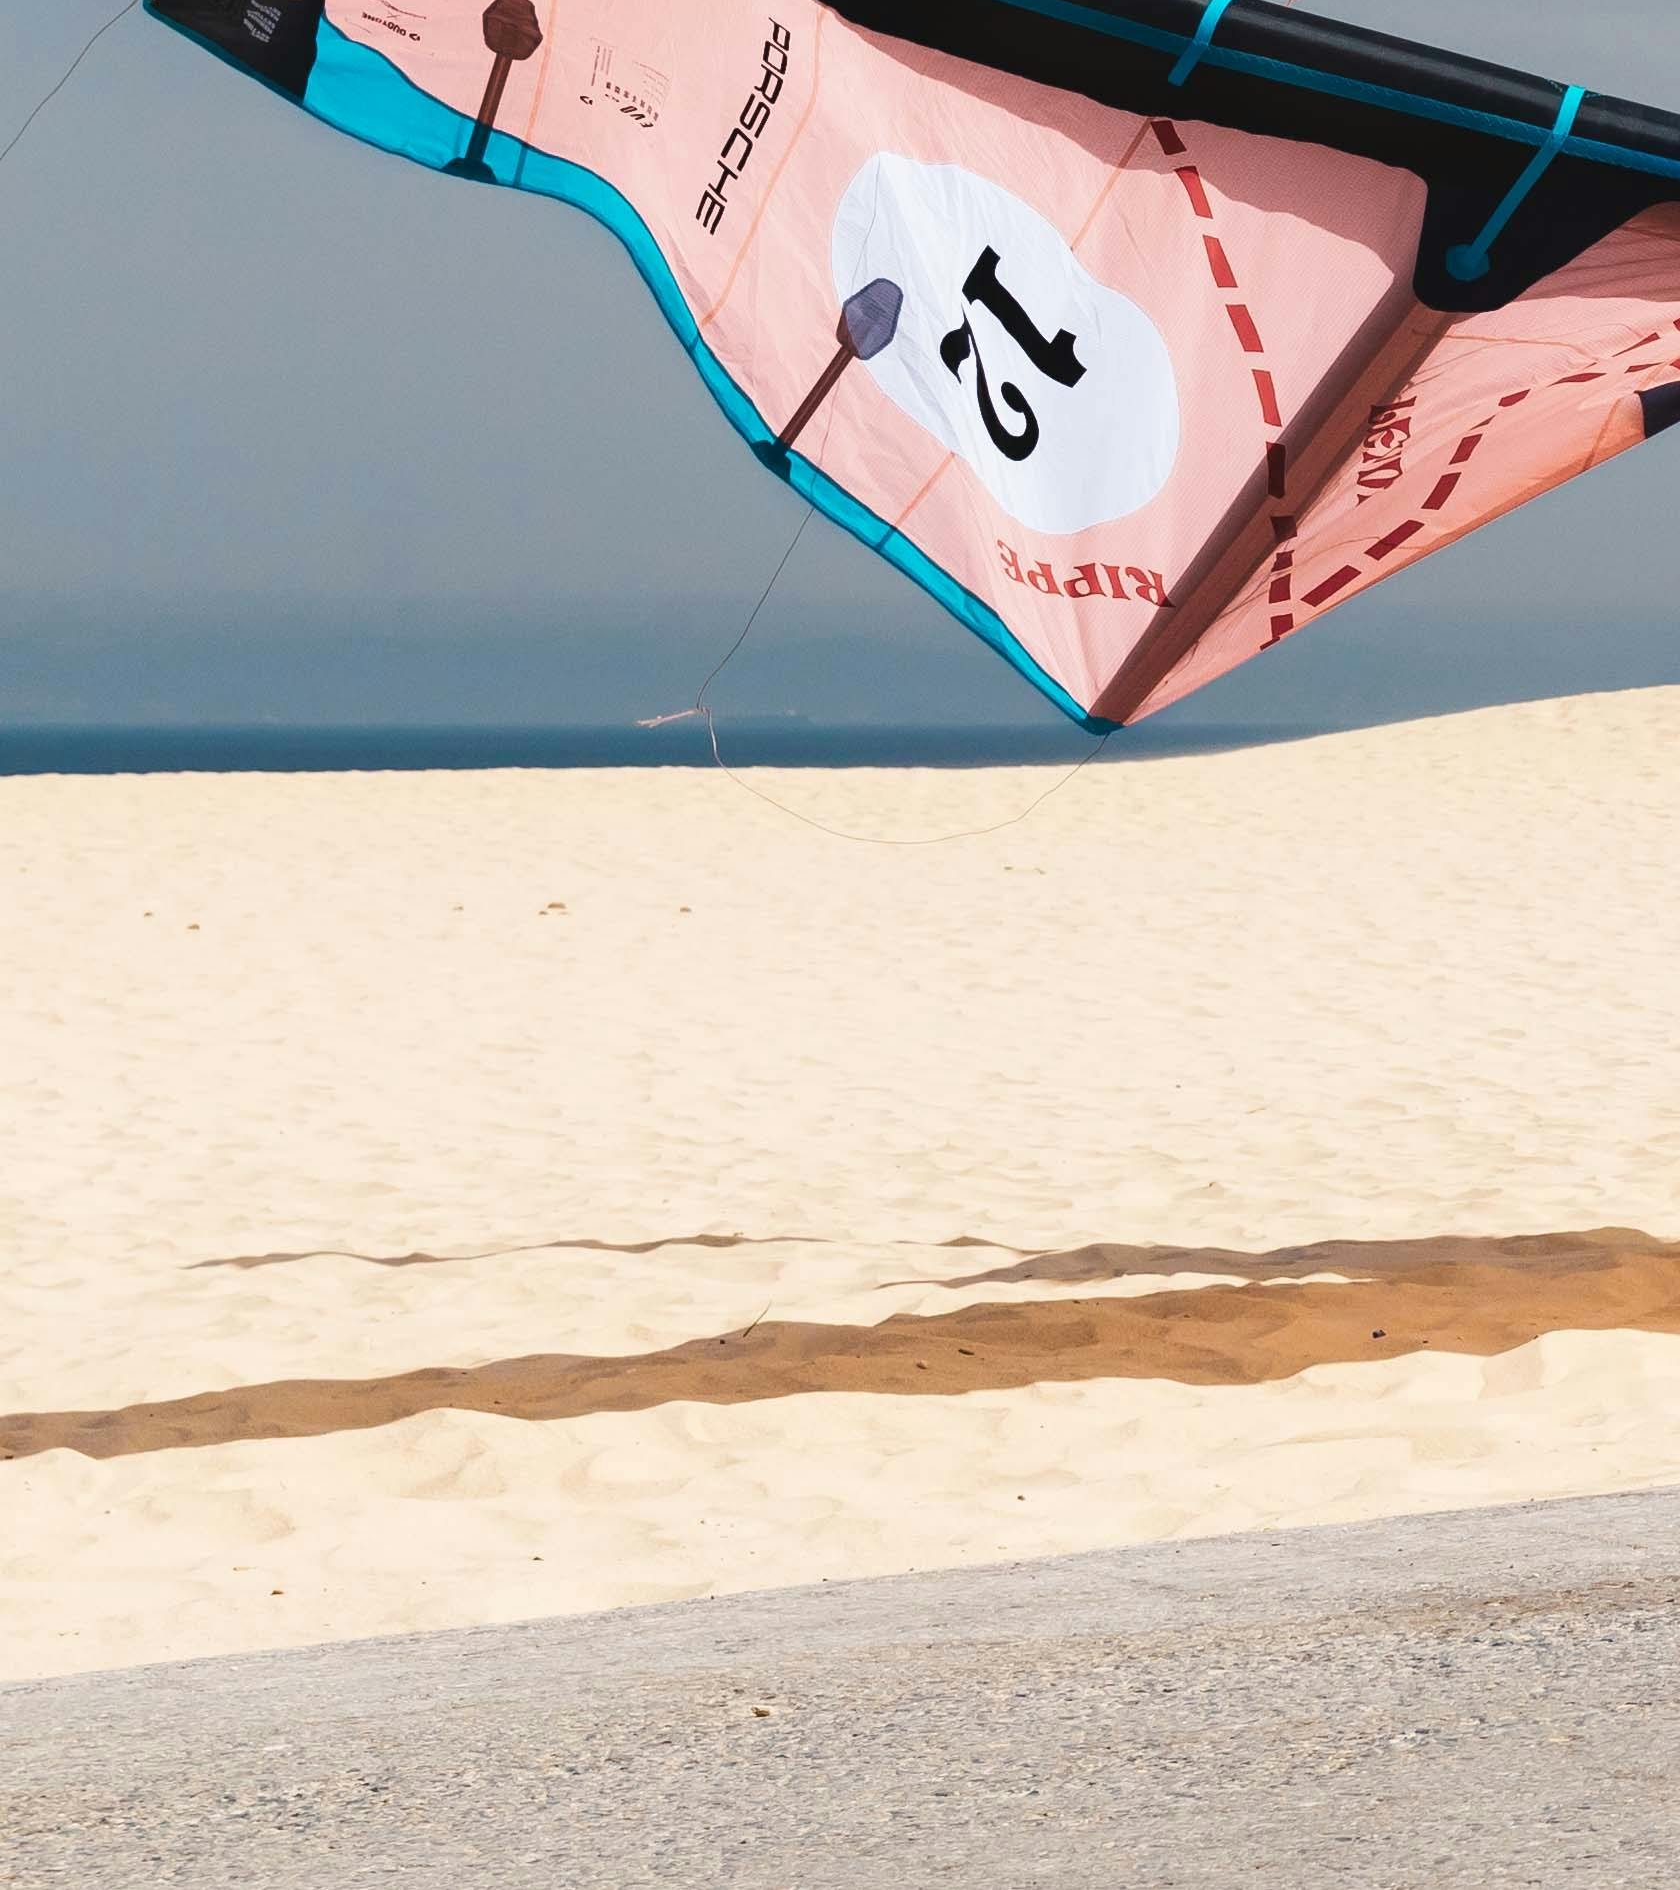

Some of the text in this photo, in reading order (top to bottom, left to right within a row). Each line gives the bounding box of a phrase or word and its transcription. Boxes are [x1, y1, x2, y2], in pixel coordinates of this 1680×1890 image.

[695, 16, 791, 235] PORSCHE
[939, 245, 1087, 462] 12
[997, 538, 1176, 608] RIPPE
